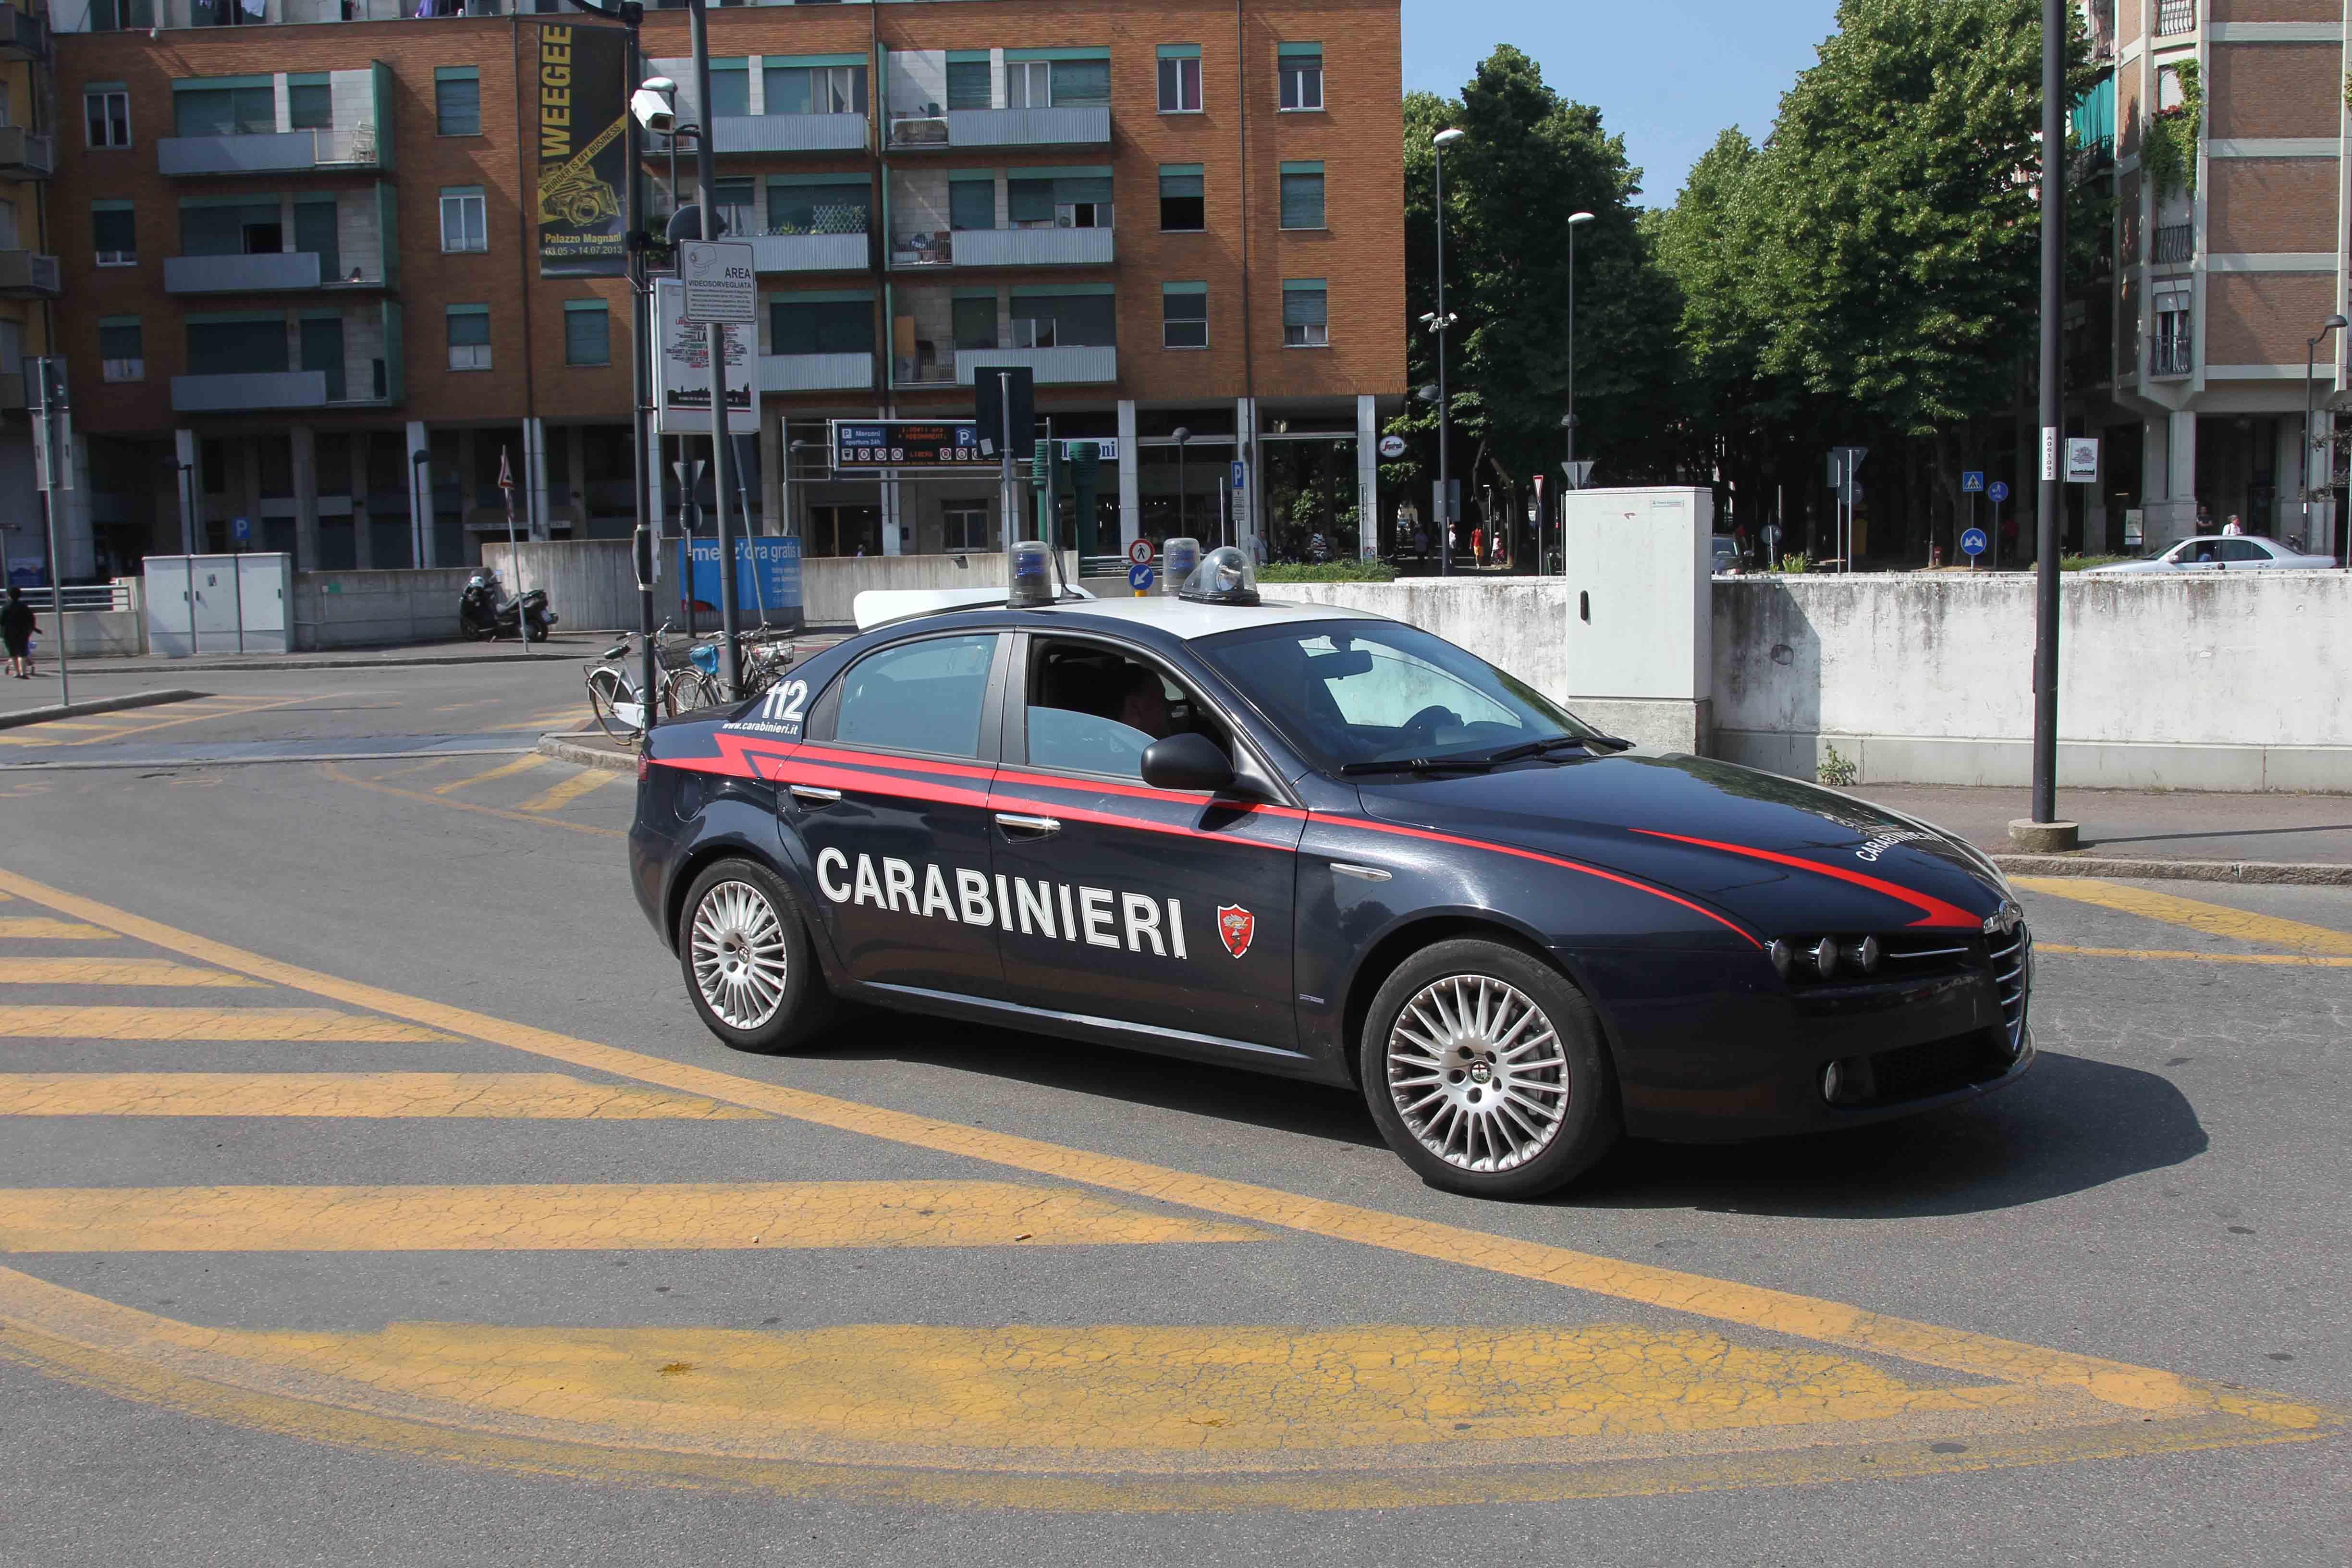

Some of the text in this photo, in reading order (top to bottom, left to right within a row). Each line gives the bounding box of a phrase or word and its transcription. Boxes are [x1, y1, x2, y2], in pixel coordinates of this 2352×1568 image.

[541, 25, 572, 158] WEEGEE
[542, 169, 572, 194] MURDER
[577, 152, 589, 164] MY
[588, 123, 621, 154] BUSINESS
[545, 232, 622, 244] Palazzo Magnani
[545, 247, 568, 255] 03.05
[579, 245, 623, 254] 14.07.2013
[725, 267, 751, 279] AREA
[688, 280, 752, 289] VIDEOSORVEGLIATA
[1234, 464, 1242, 485] P
[237, 519, 247, 537] P
[771, 542, 796, 563] gratis
[762, 680, 808, 722] 112
[722, 722, 799, 735] www.carabinieri.it
[817, 847, 1187, 959] CARABINIERI
